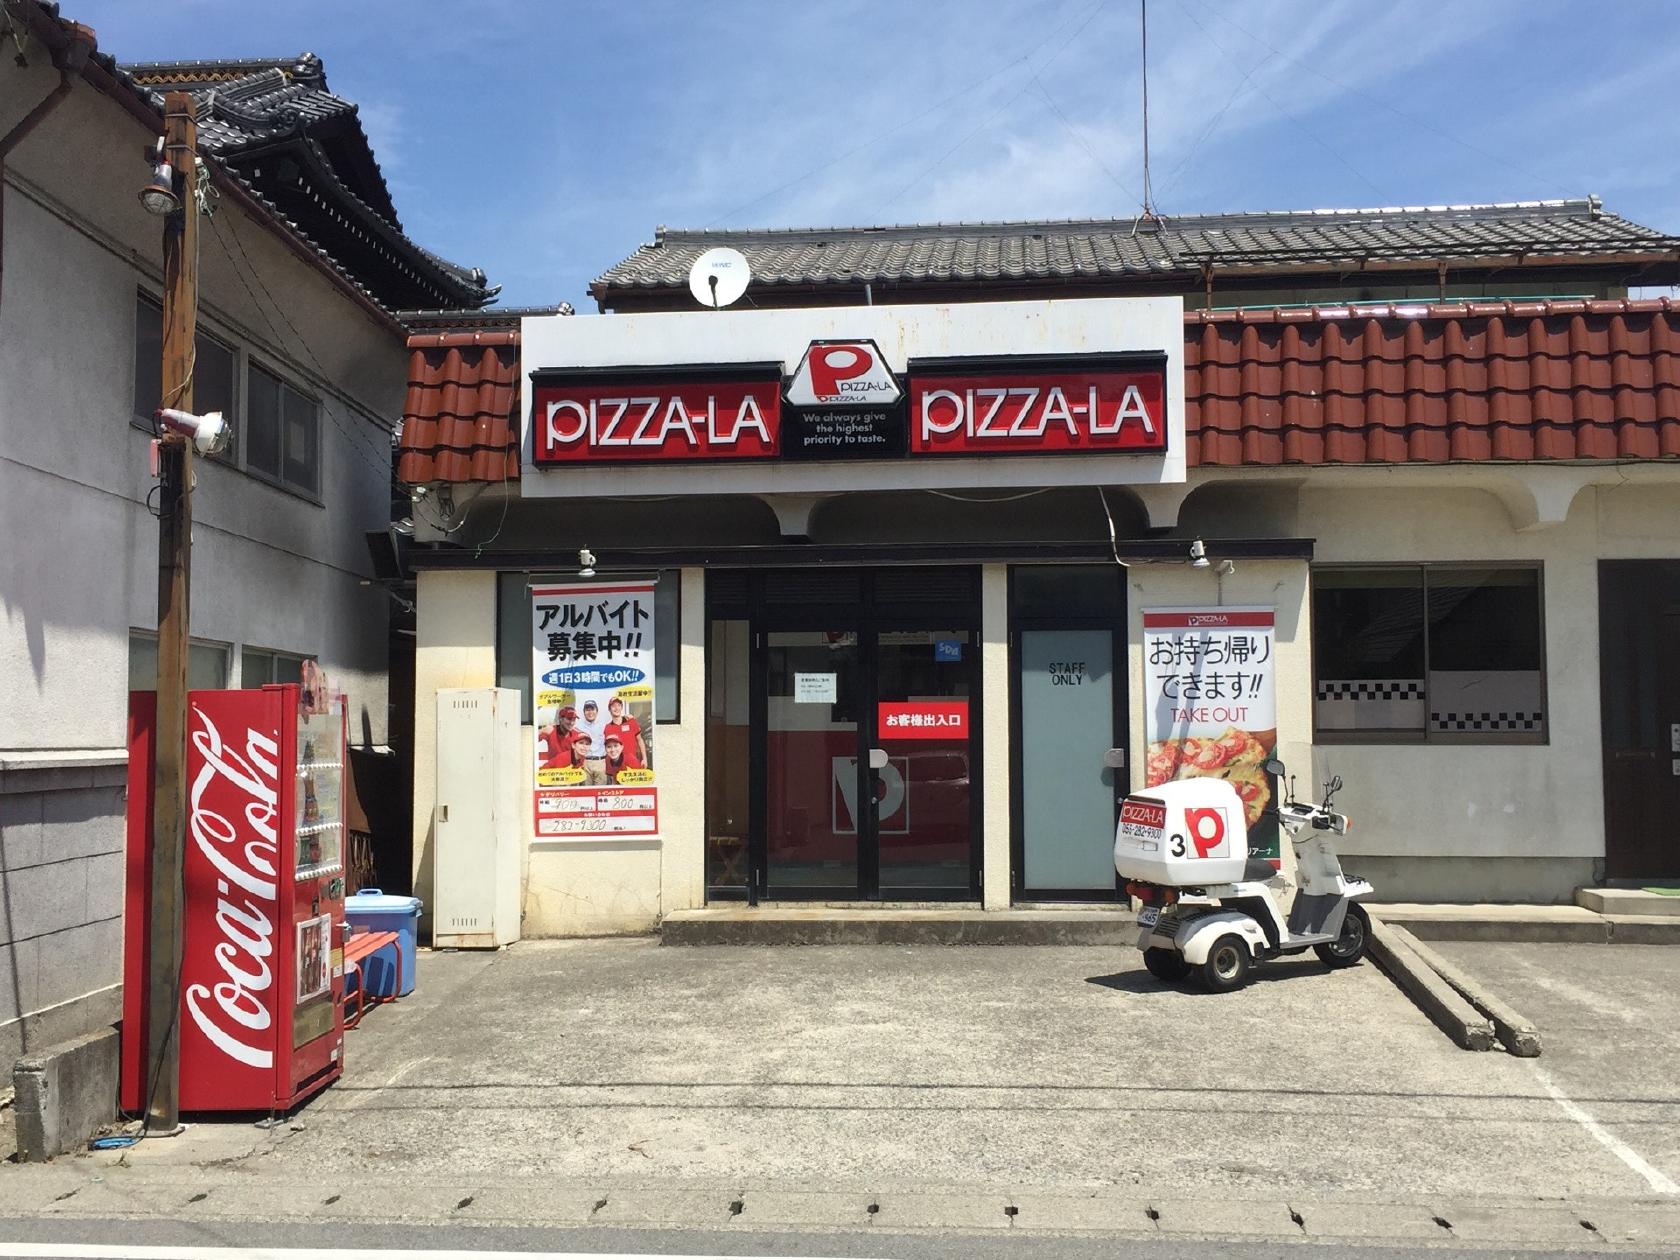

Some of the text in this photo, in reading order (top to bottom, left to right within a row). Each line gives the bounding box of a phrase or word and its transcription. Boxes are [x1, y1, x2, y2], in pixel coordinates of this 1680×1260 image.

[547, 395, 771, 450] PIZZA-LA
[803, 411, 886, 424] We always give
[922, 385, 1154, 441] PIZZA-LA
[804, 434, 886, 446] priority to taste.
[816, 424, 873, 435] the highest
[536, 600, 650, 630] アルバイト
[547, 630, 642, 661] 募集中!!
[1150, 635, 1269, 665] お持ち帰り
[1048, 662, 1086, 674] STAFF
[1052, 674, 1083, 686] ONLY
[1157, 671, 1263, 700] できます!!
[885, 713, 961, 727] お客様出入口
[1171, 707, 1248, 722] TAKE OUT
[1122, 805, 1164, 824] PIZZA-LA
[1169, 833, 1186, 858] 3
[186, 702, 279, 1068] Coca-Cola
